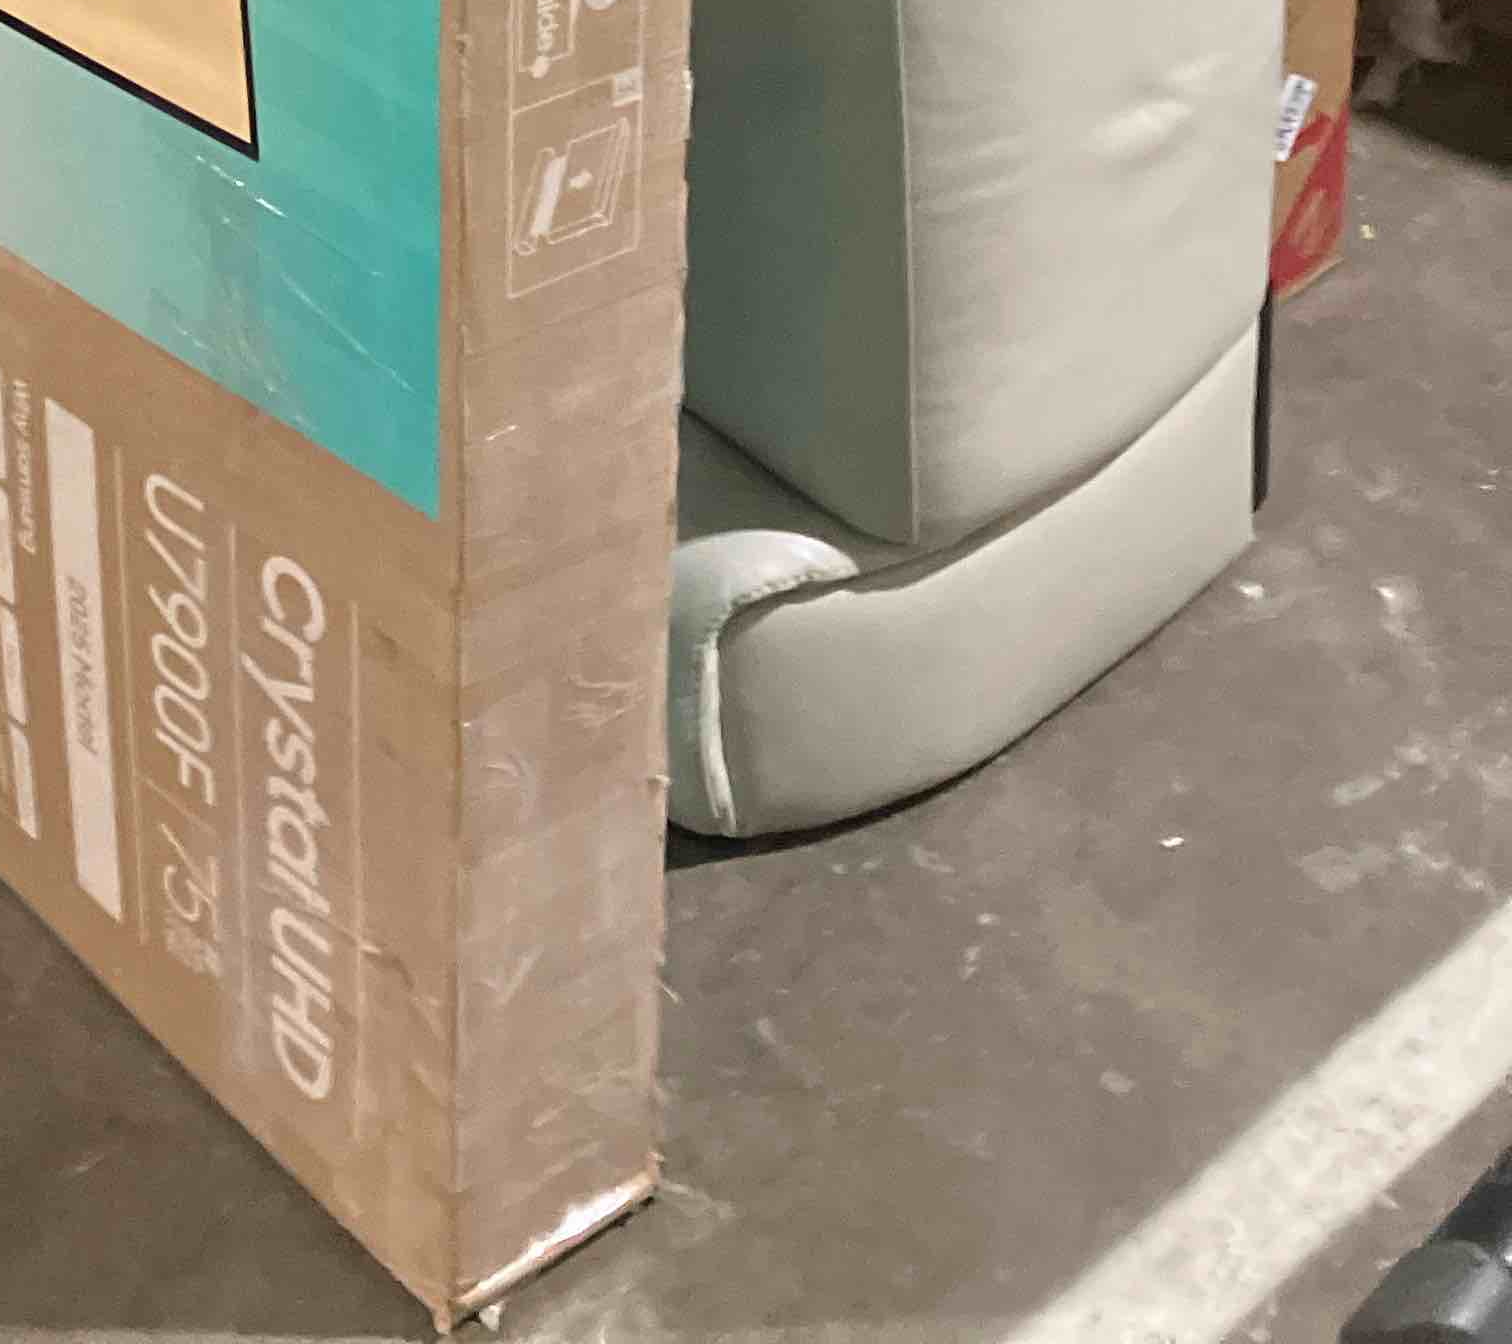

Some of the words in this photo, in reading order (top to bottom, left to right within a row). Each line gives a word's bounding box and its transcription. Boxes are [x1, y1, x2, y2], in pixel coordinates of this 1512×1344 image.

[143, 473, 217, 806] U7900F
[241, 555, 332, 916] Crystal
[270, 907, 334, 1101] UHD
